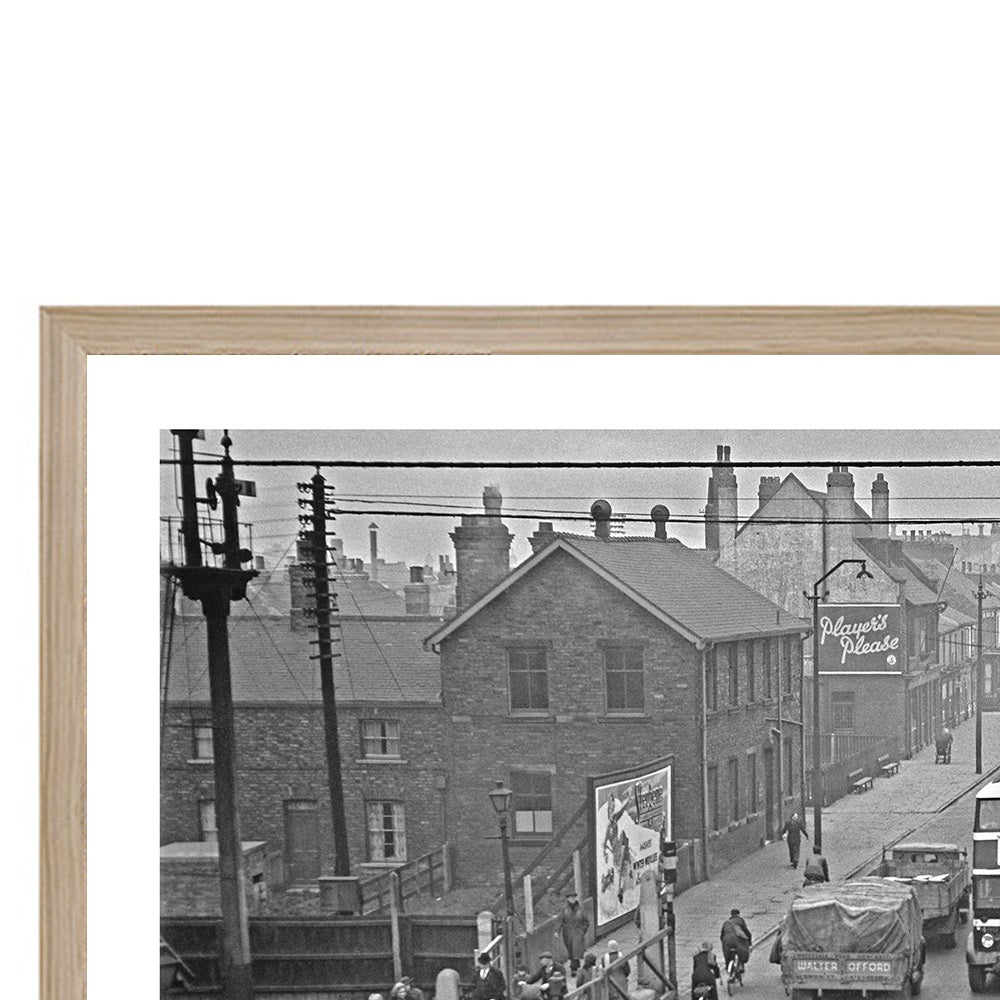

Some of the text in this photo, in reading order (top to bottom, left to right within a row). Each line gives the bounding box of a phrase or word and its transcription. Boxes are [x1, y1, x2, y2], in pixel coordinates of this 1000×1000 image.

[820, 614, 889, 645] Player's
[840, 635, 900, 664] Please
[797, 961, 891, 972] WALTER OFFORD
